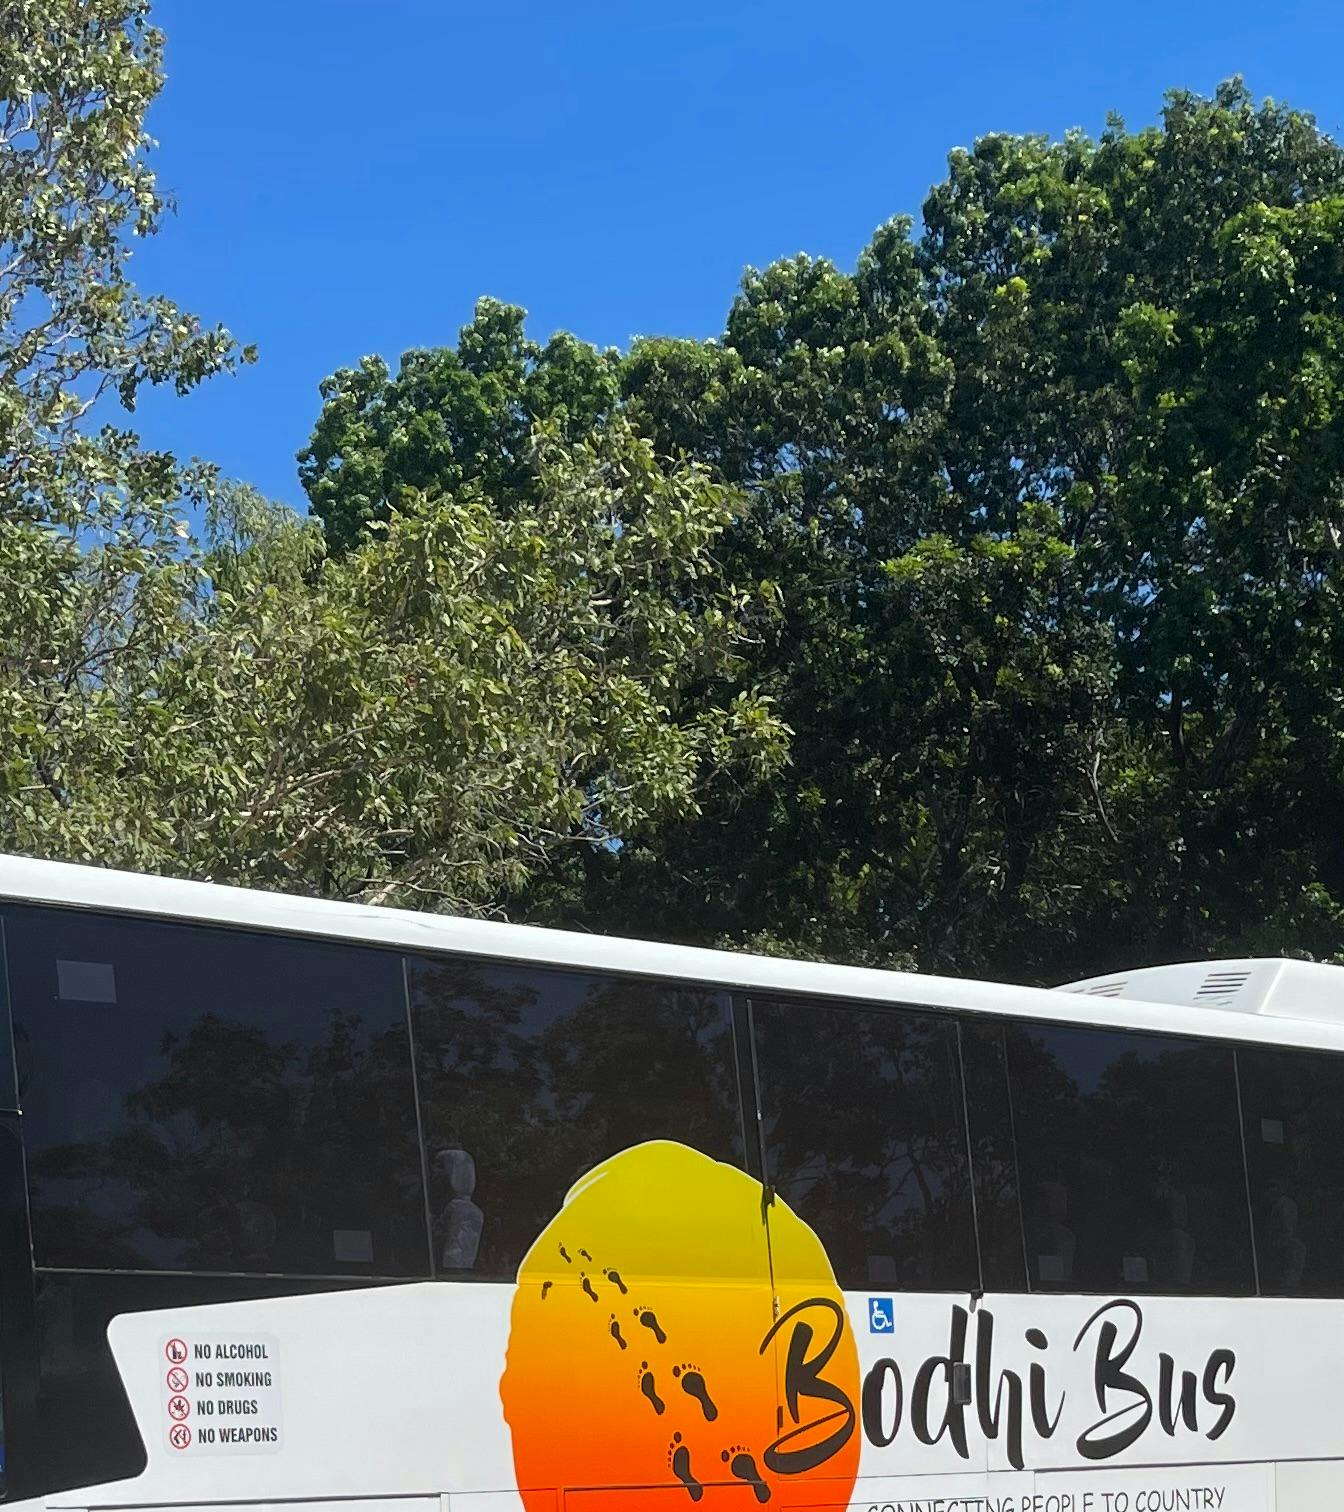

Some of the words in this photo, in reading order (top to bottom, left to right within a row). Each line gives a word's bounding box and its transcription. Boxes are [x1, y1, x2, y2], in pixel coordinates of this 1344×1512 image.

[194, 1344, 211, 1359] NO
[216, 1344, 268, 1359] ALCOHOL
[196, 1372, 212, 1387] NO
[217, 1372, 272, 1387] SMOKING
[759, 1297, 1066, 1470] Bodhi
[1073, 1298, 1236, 1460] Bus
[197, 1400, 214, 1415] NO
[218, 1400, 258, 1415] DRUGS
[198, 1428, 215, 1443] NO
[219, 1427, 278, 1442] WEAPONS
[1135, 1487, 1226, 1512] COUNTRY
